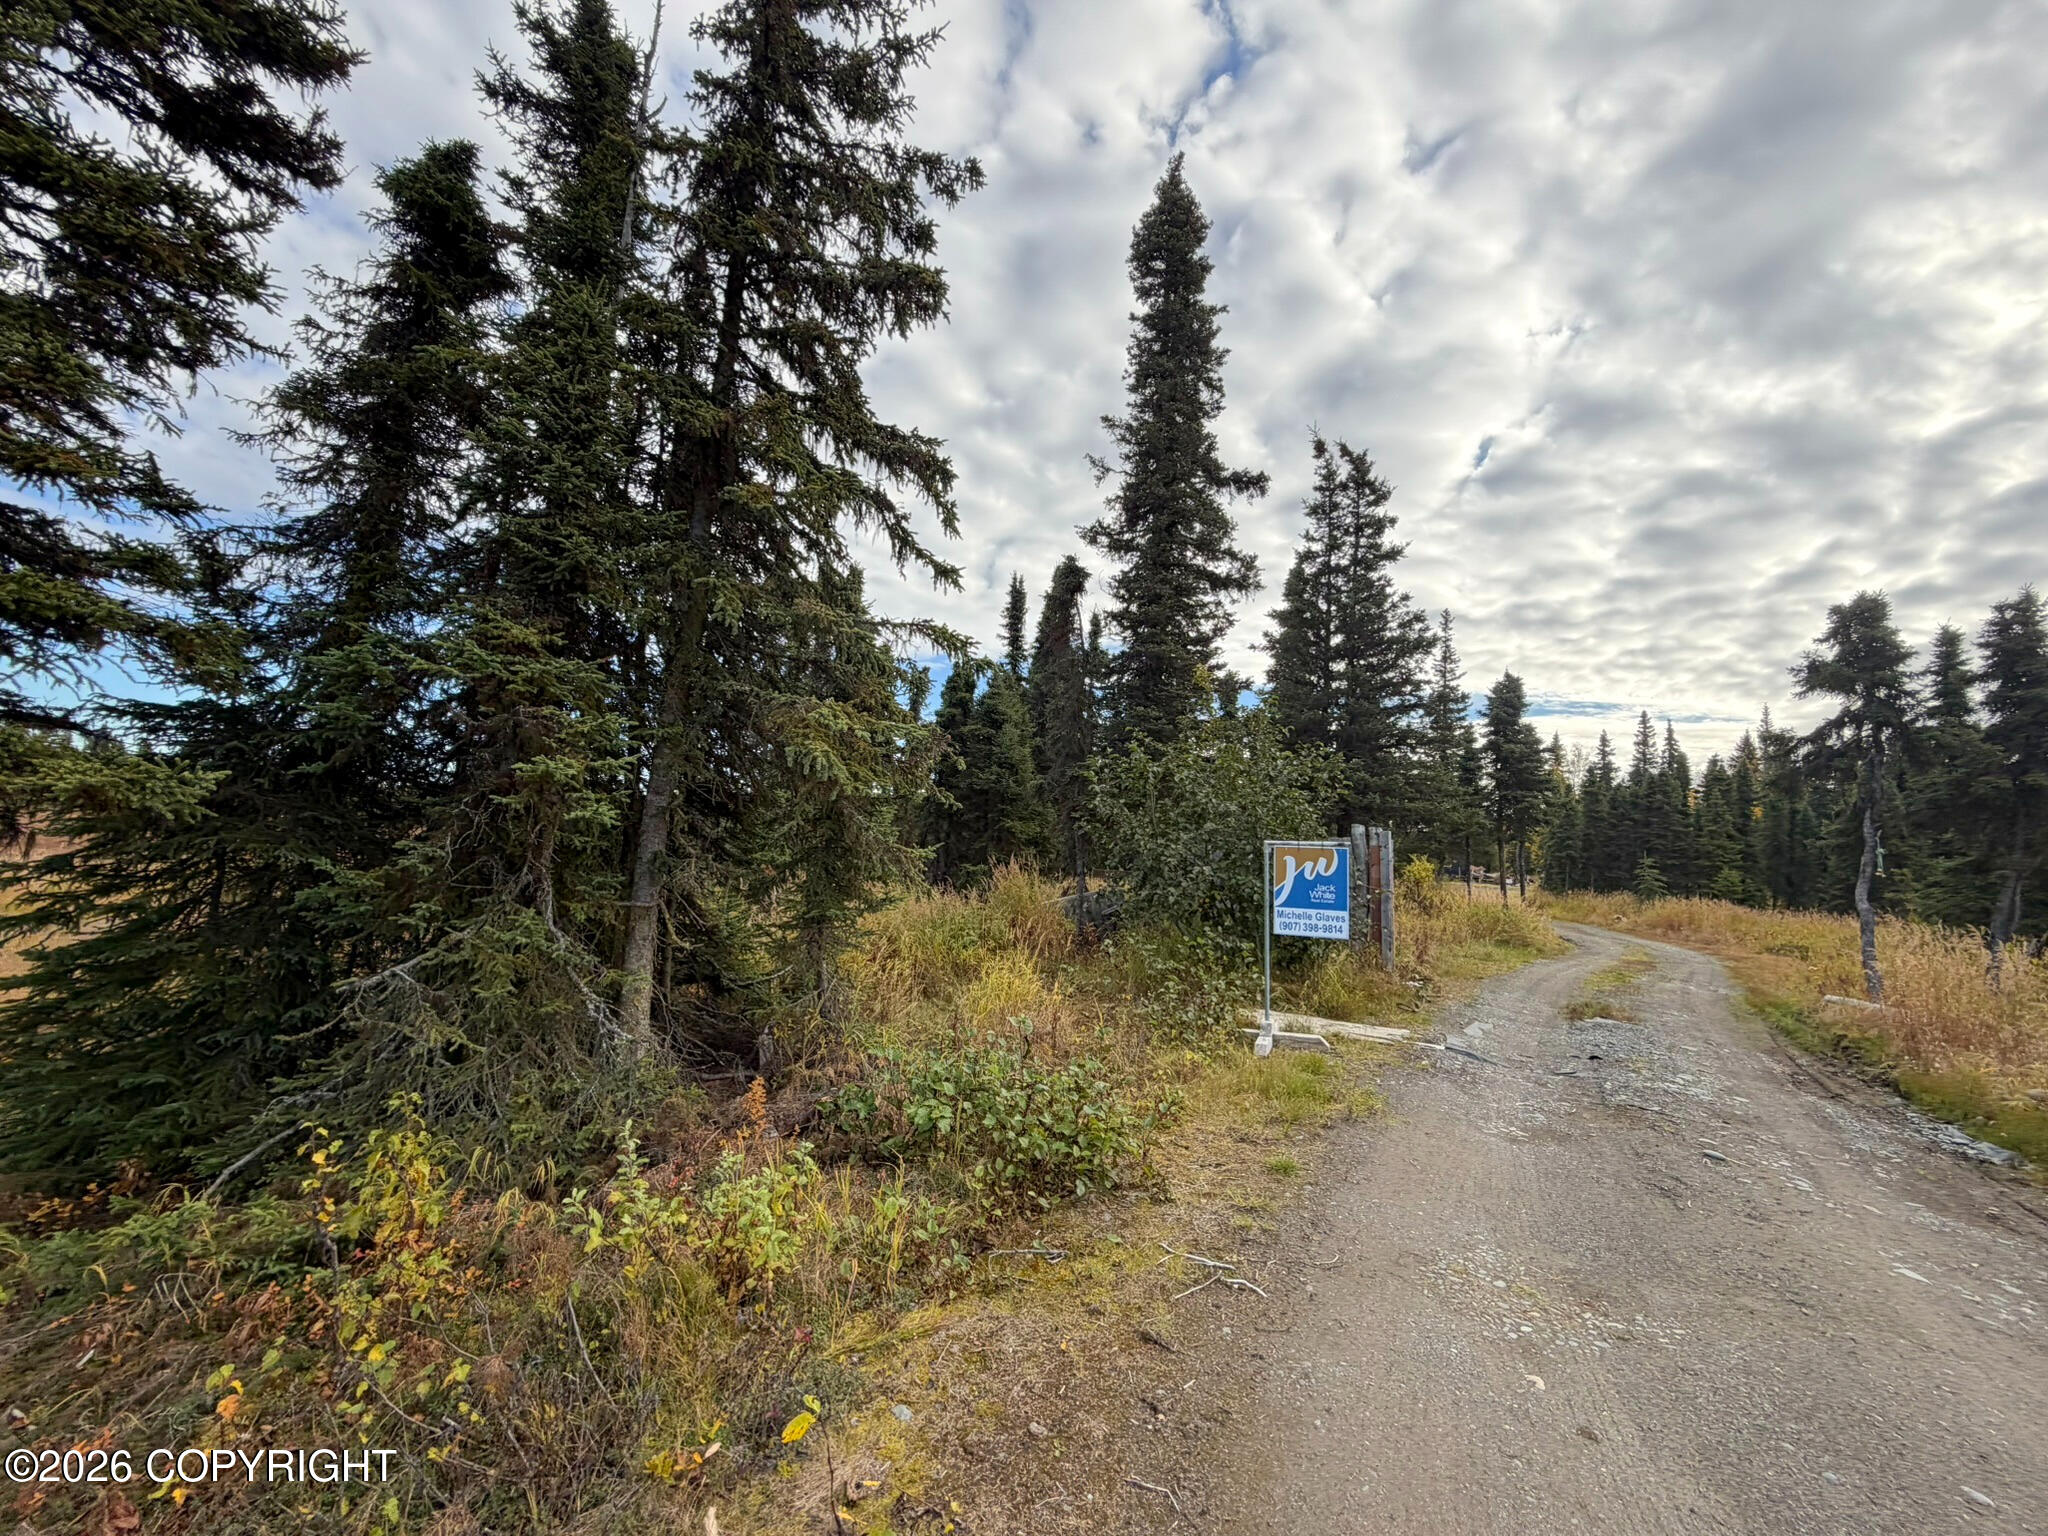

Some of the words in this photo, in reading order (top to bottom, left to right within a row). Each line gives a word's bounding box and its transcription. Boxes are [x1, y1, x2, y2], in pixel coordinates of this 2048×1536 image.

[1315, 883, 1336, 892] Jack
[1309, 890, 1336, 900] White
[1276, 909, 1313, 920] Michelle
[1315, 911, 1346, 922] Glaves
[1279, 920, 1301, 931] (907)
[1303, 922, 1343, 934] 398-9814
